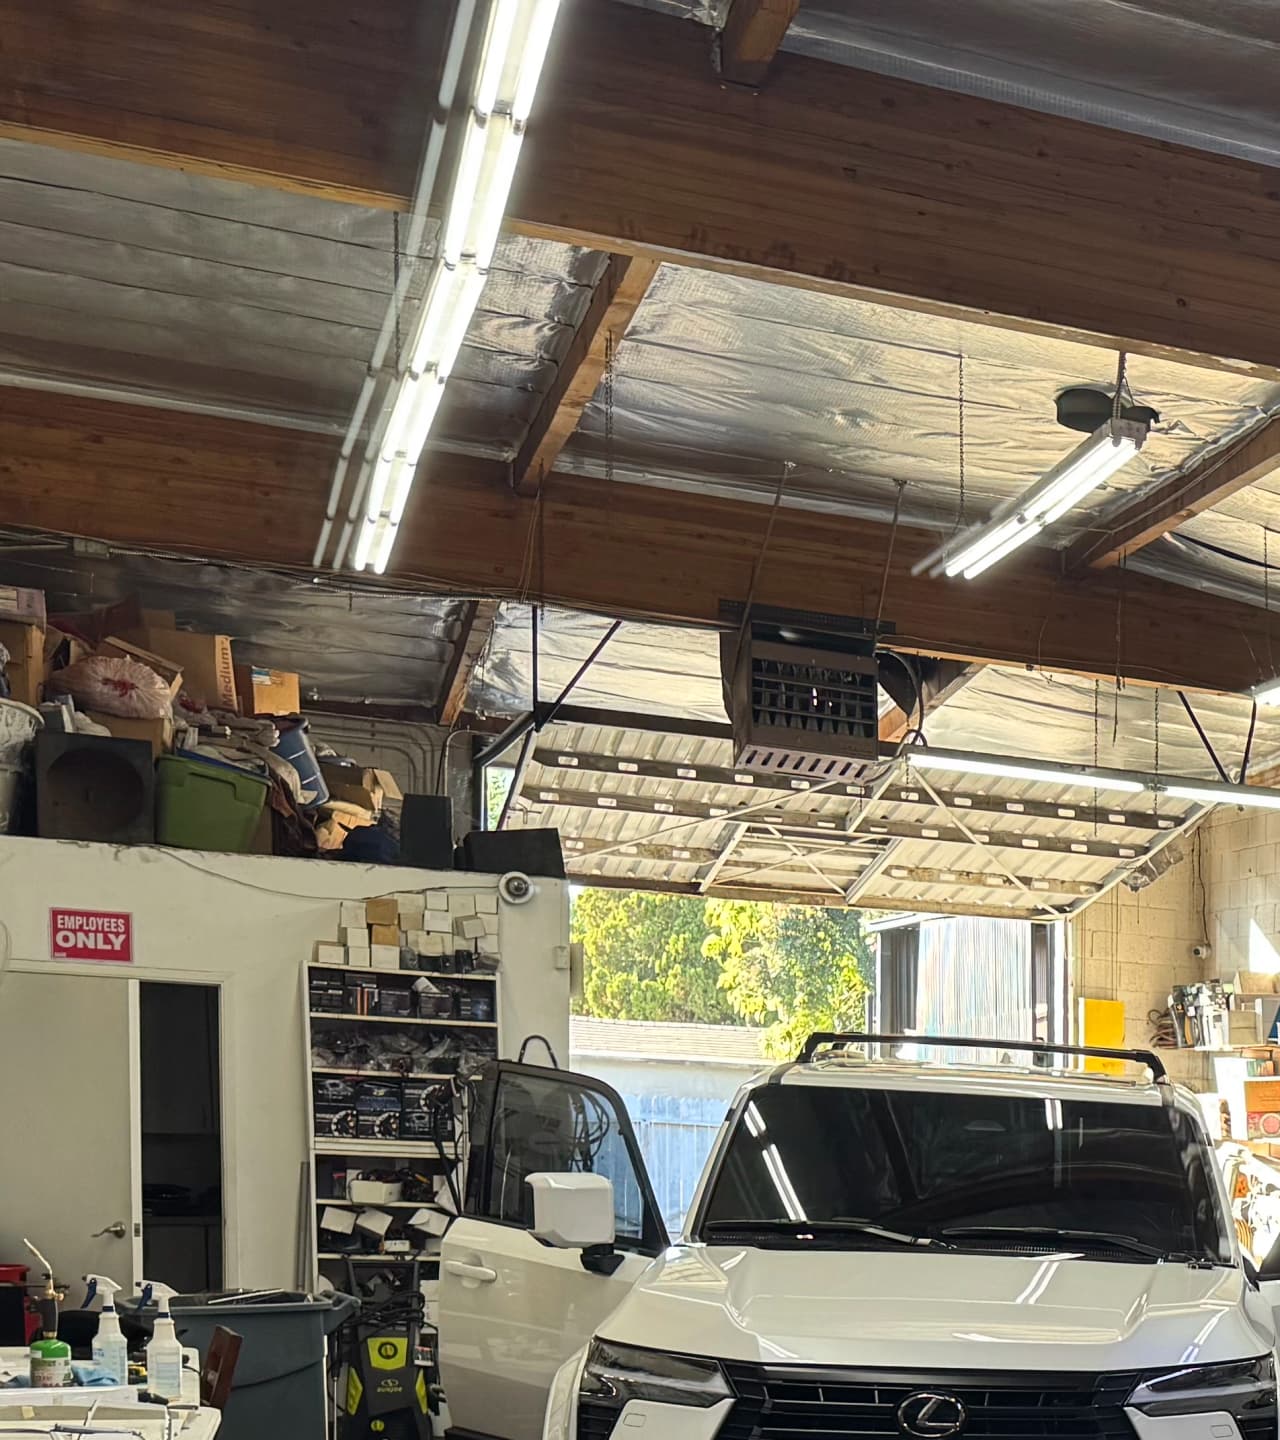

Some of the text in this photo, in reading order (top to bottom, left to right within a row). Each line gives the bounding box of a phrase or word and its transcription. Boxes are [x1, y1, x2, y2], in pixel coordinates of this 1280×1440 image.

[219, 639, 234, 708] Medium
[57, 915, 126, 933] EMPLOYEES
[55, 932, 127, 951] ONLY
